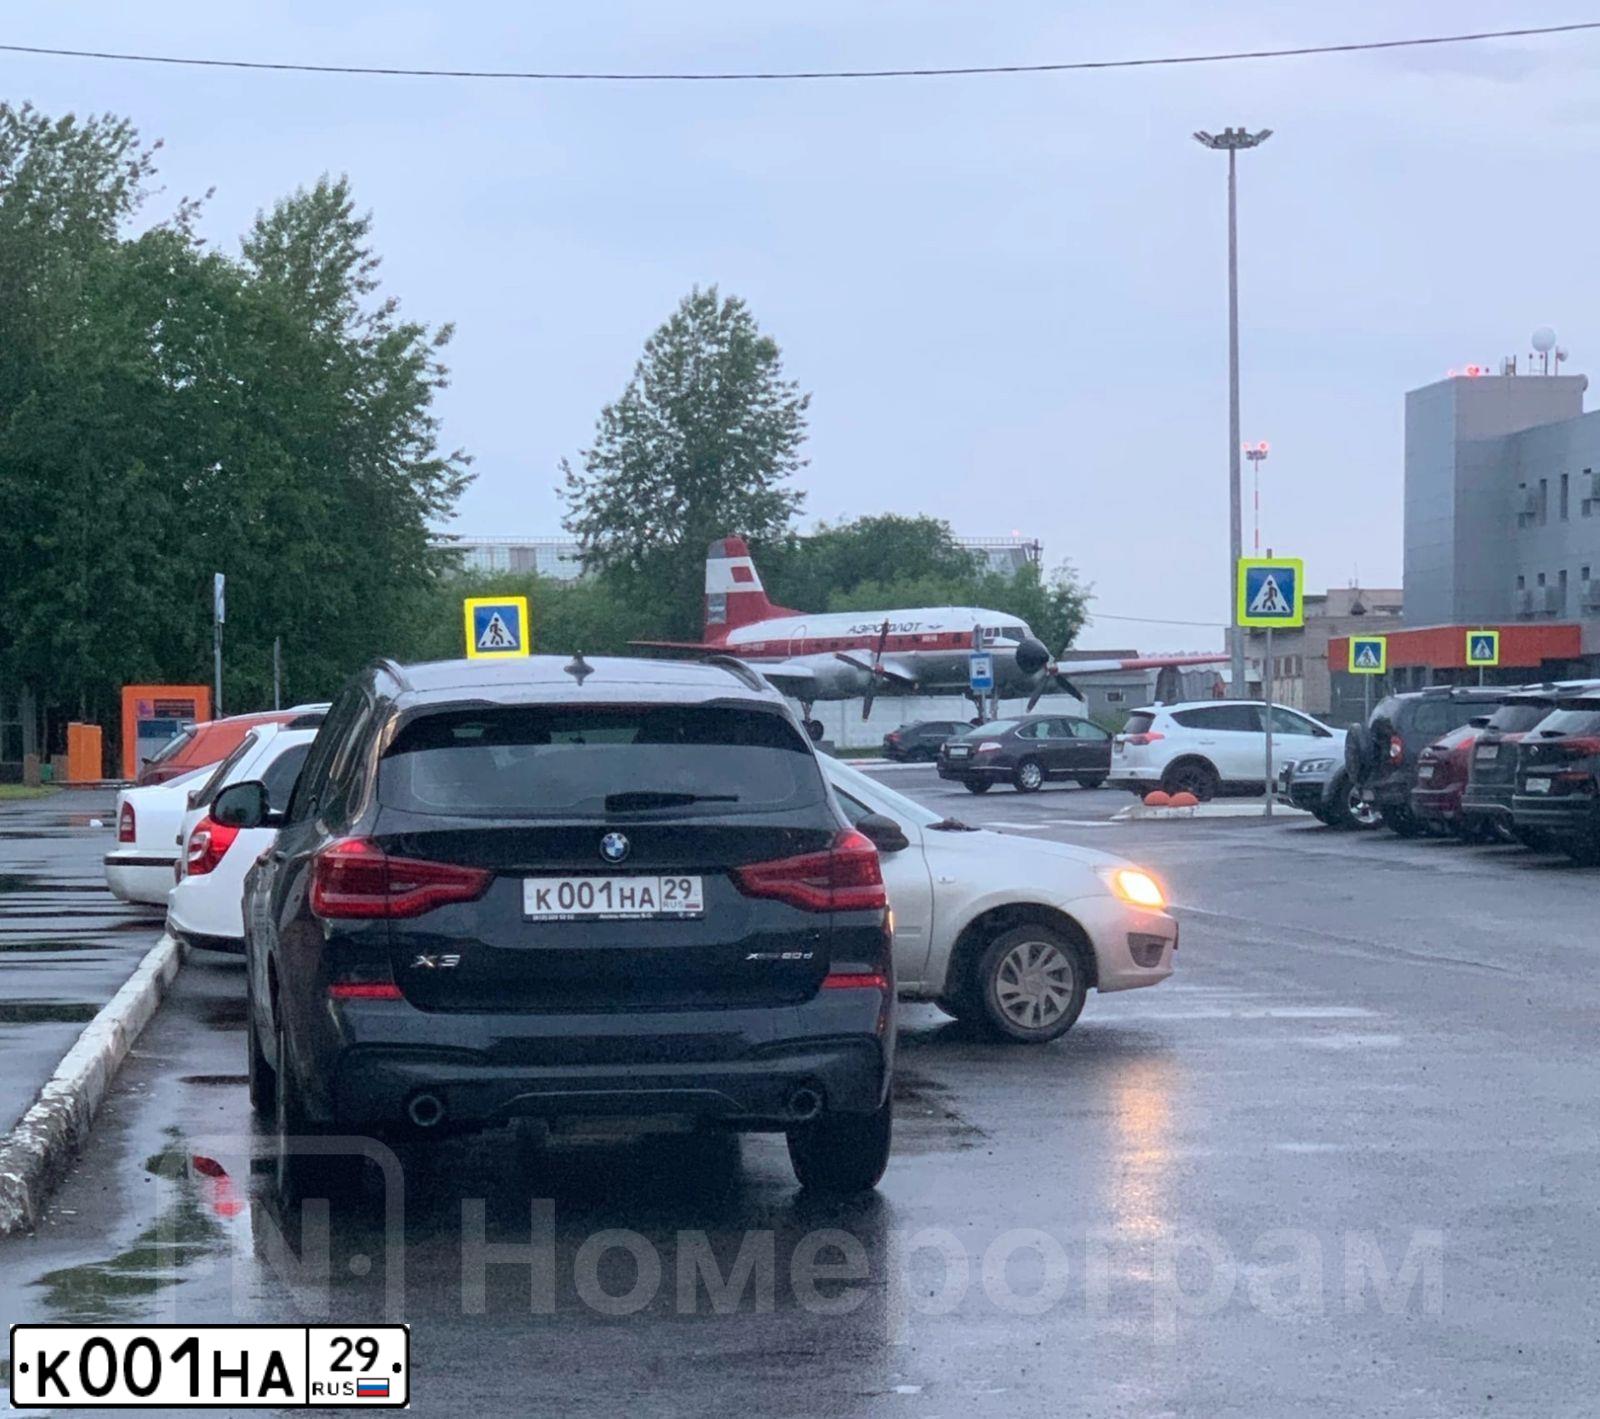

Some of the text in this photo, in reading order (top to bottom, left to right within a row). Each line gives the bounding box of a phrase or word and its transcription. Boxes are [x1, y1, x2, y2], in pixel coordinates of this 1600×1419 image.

[664, 879, 692, 900] 29
[663, 900, 685, 909] RUS
[409, 954, 461, 969] X3
